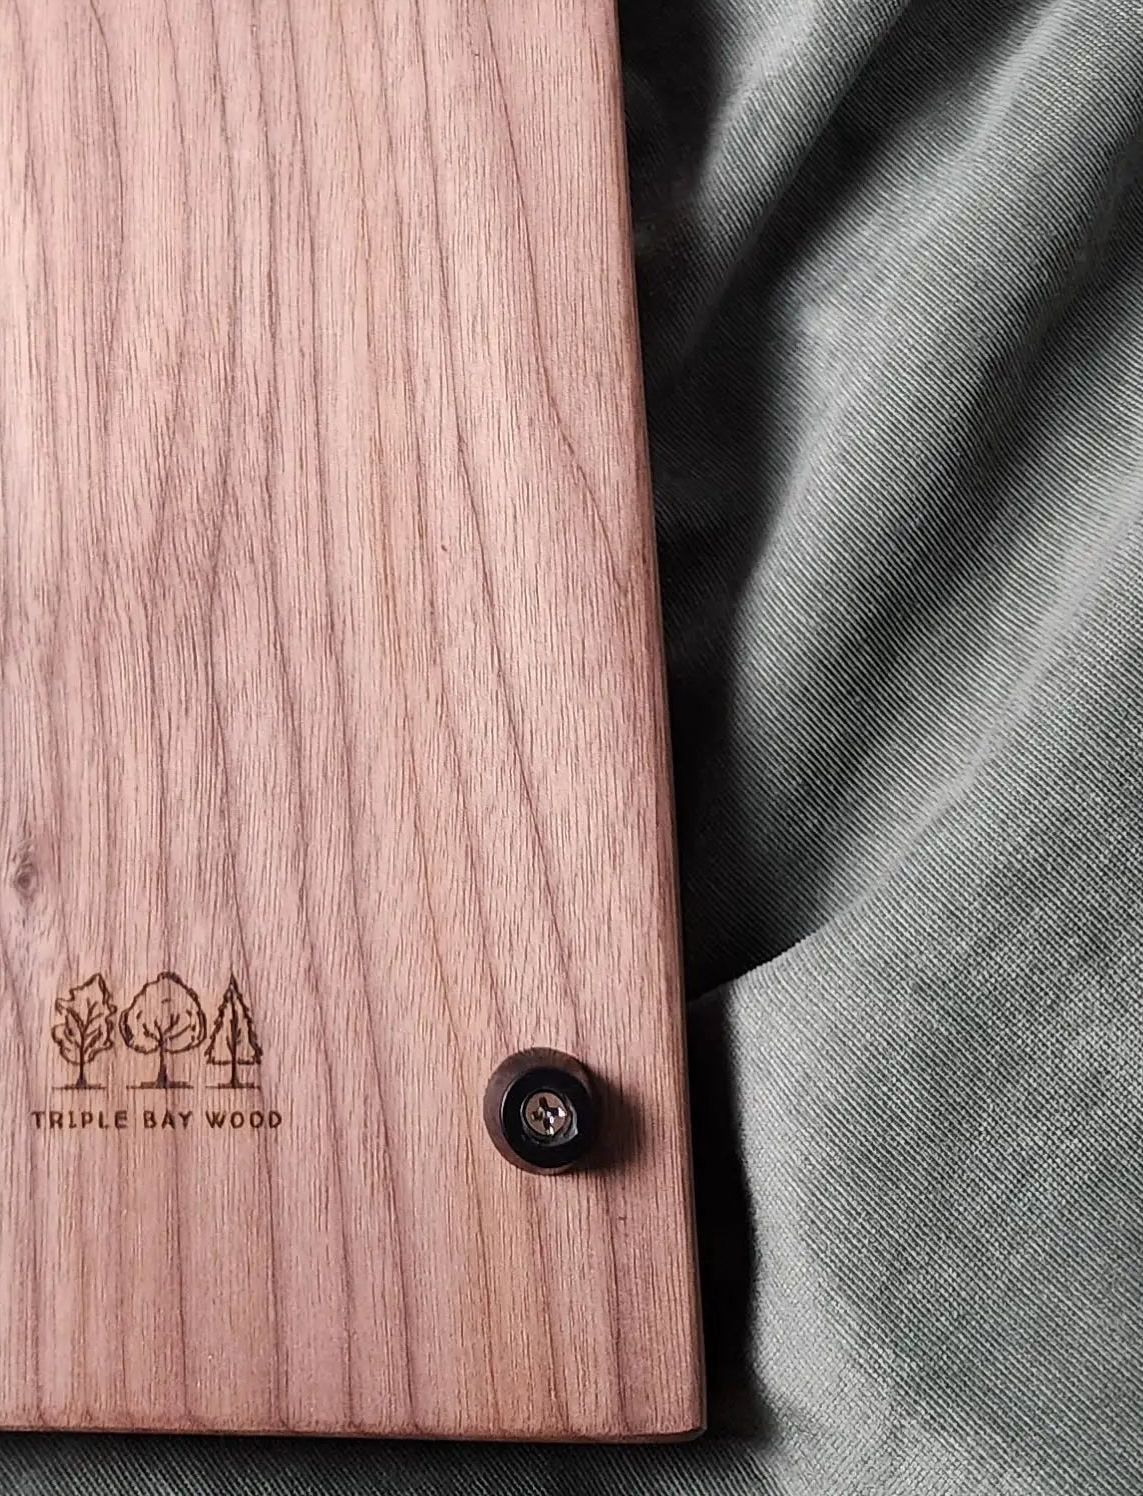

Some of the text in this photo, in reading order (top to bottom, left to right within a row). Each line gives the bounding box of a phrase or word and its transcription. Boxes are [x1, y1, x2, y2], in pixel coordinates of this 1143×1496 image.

[31, 1109, 283, 1130] TRIPLE BAY WOOD
